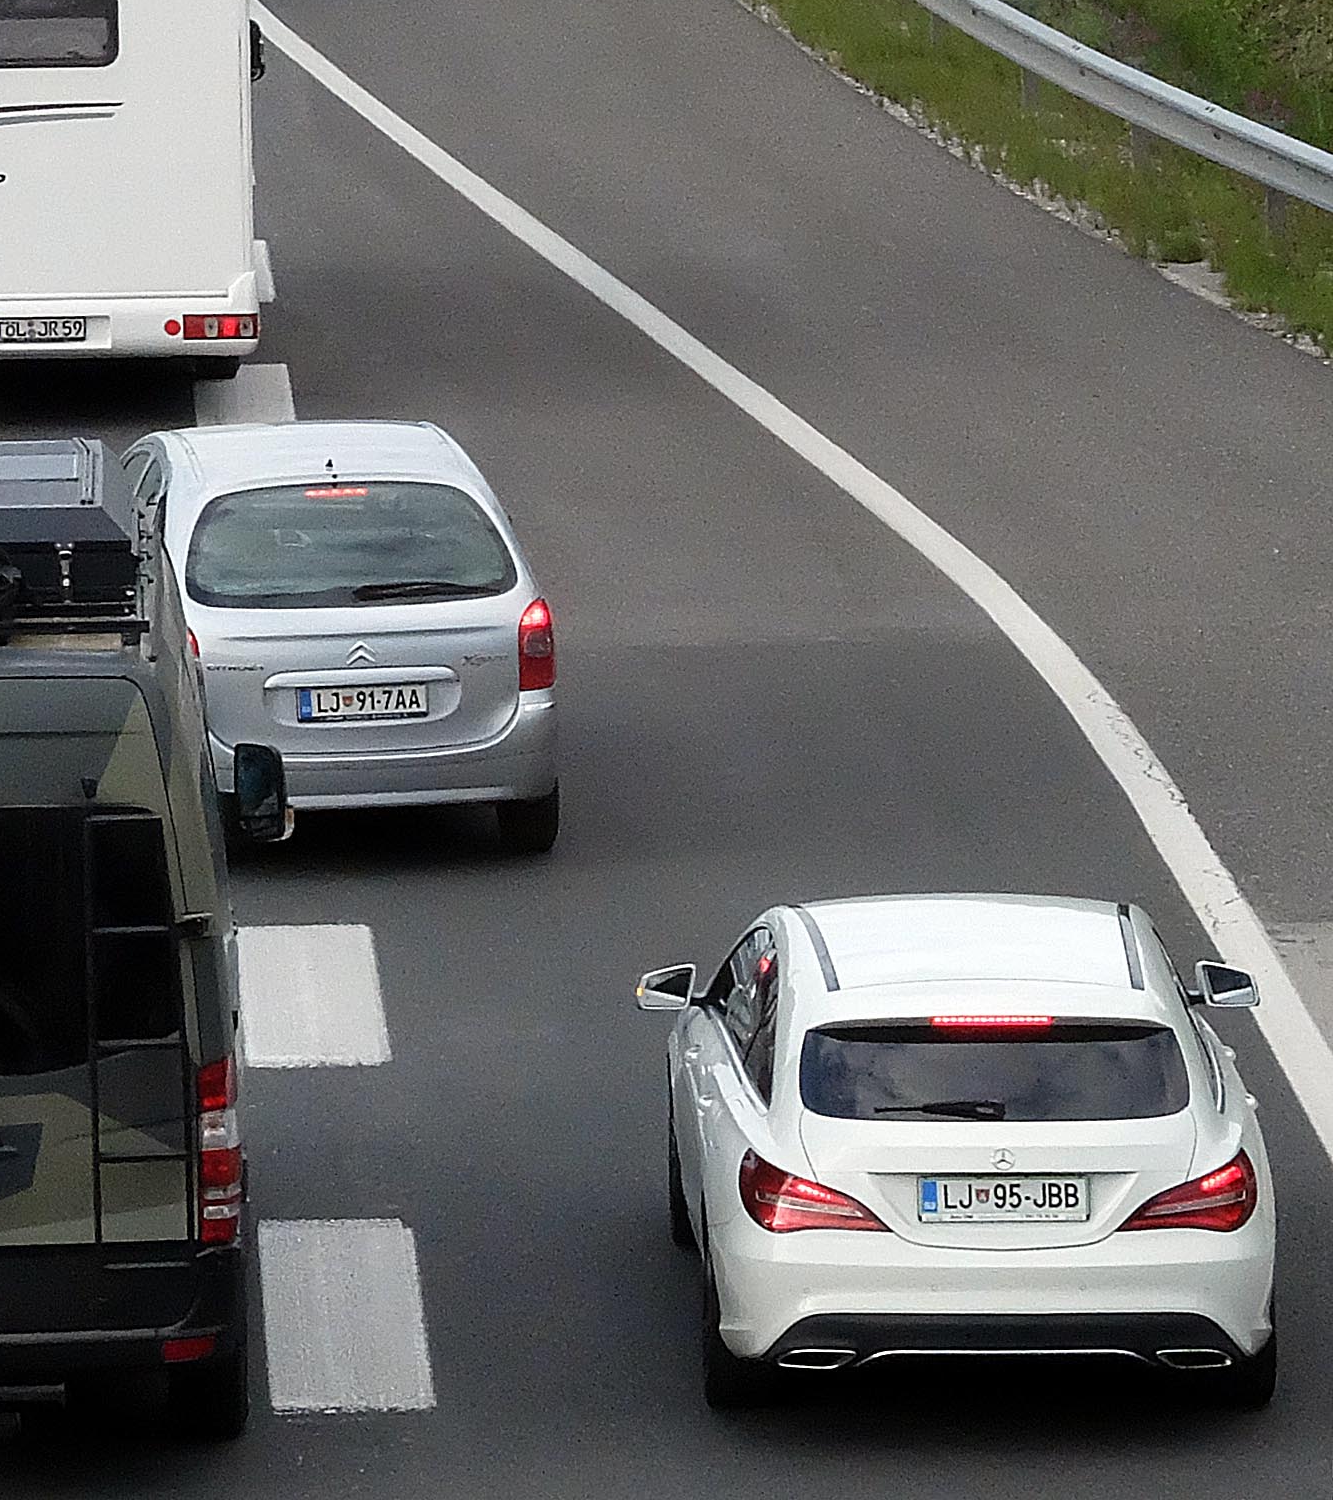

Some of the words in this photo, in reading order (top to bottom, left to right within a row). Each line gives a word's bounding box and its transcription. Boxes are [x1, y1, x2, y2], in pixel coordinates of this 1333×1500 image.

[37, 320, 59, 337] JR
[62, 320, 83, 337] 59
[316, 692, 340, 715] LJ
[355, 688, 421, 711] 91-7AA
[943, 1183, 973, 1209] LJ
[993, 1182, 1080, 1209] 95-JBB
